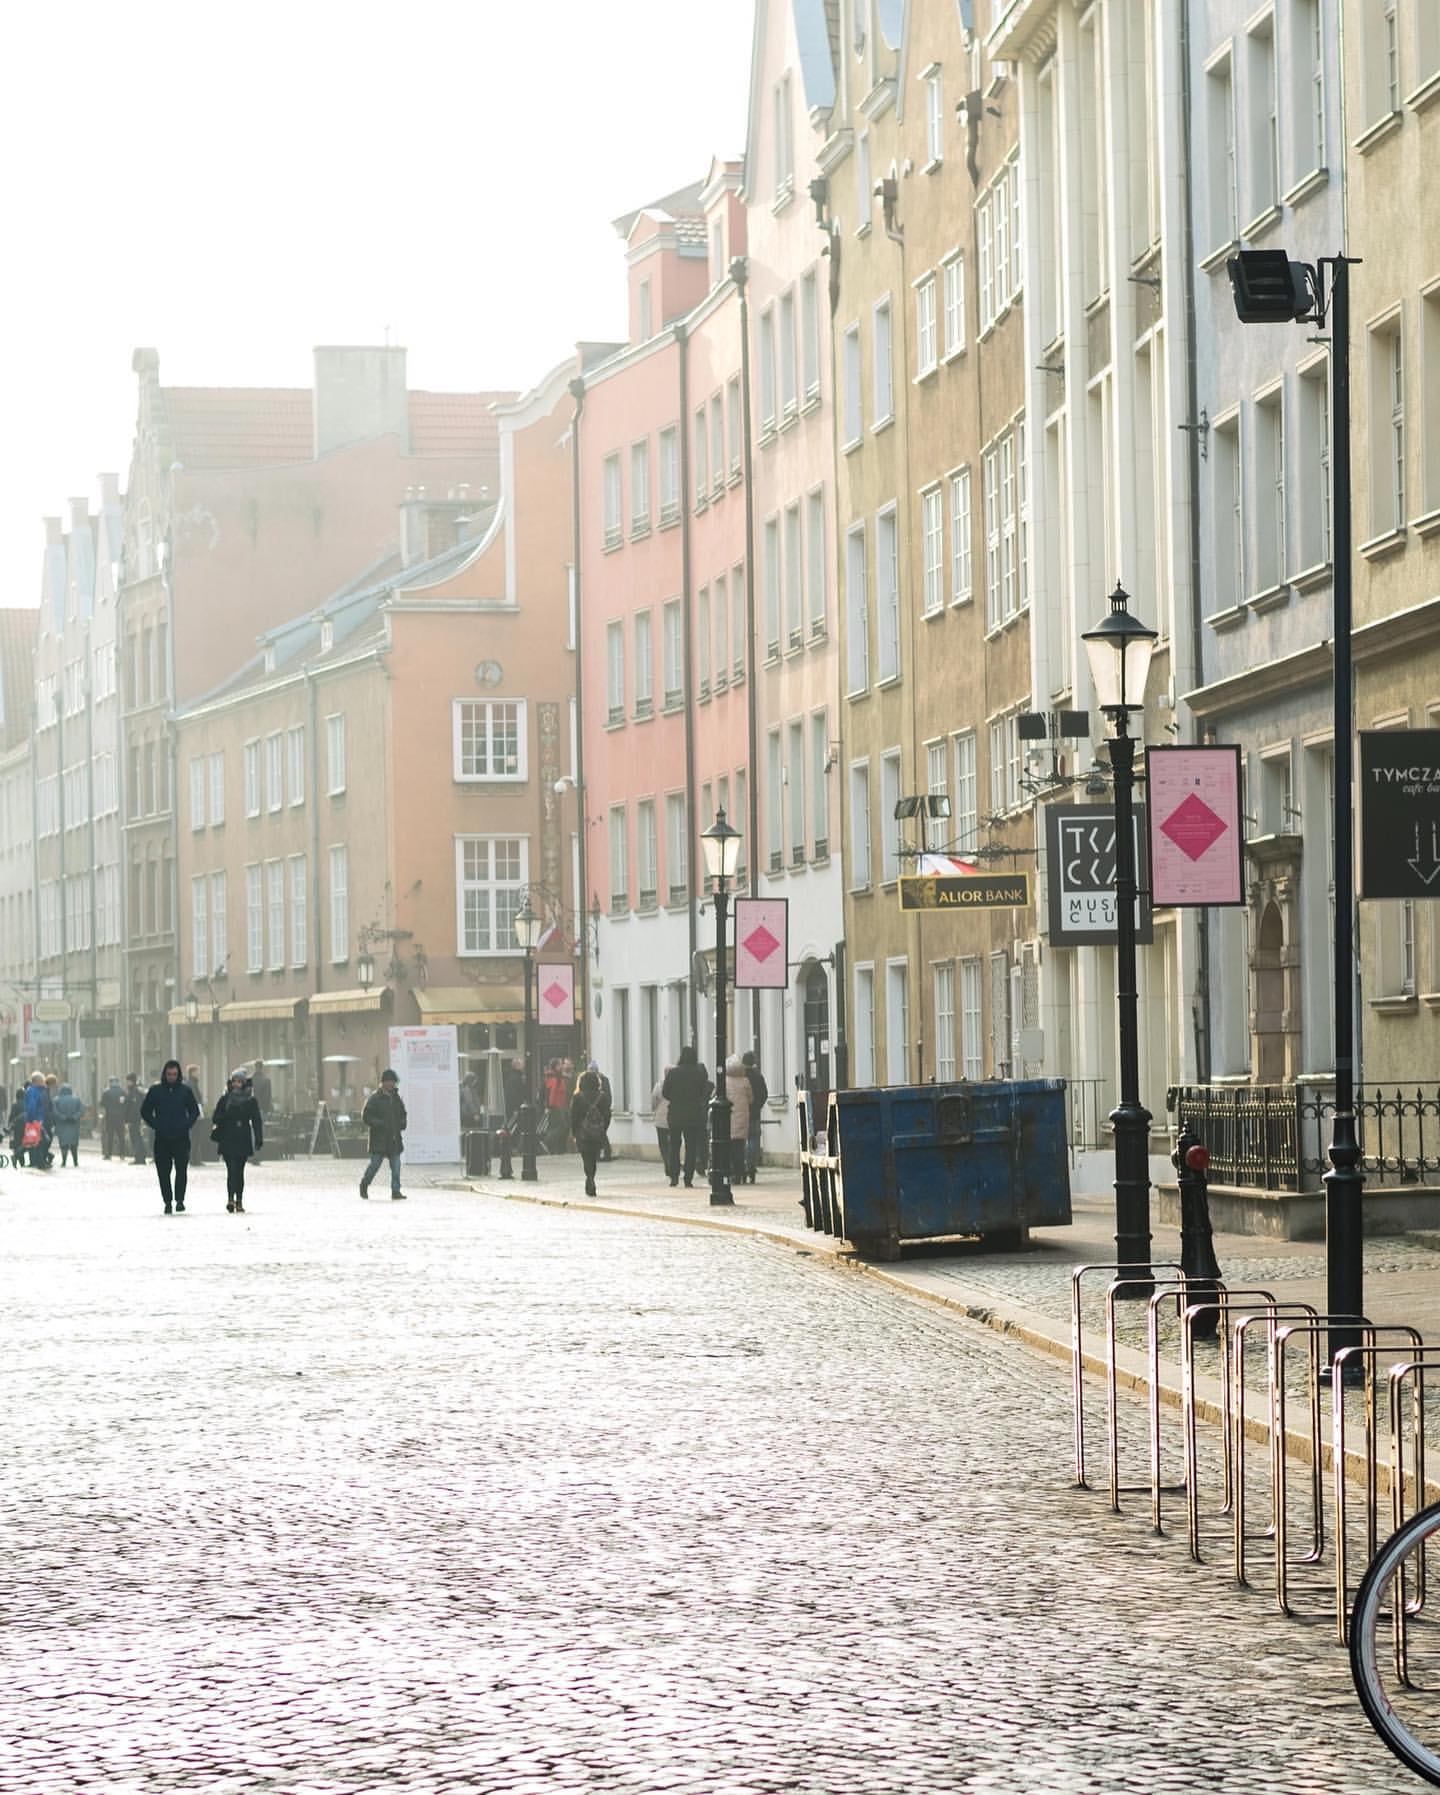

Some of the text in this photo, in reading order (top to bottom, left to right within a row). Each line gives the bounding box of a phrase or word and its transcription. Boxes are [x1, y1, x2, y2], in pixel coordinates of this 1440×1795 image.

[938, 889, 1023, 904] ALIOR BANK
[1070, 898, 1117, 911] MUSI
[1070, 911, 1115, 924] CLU
